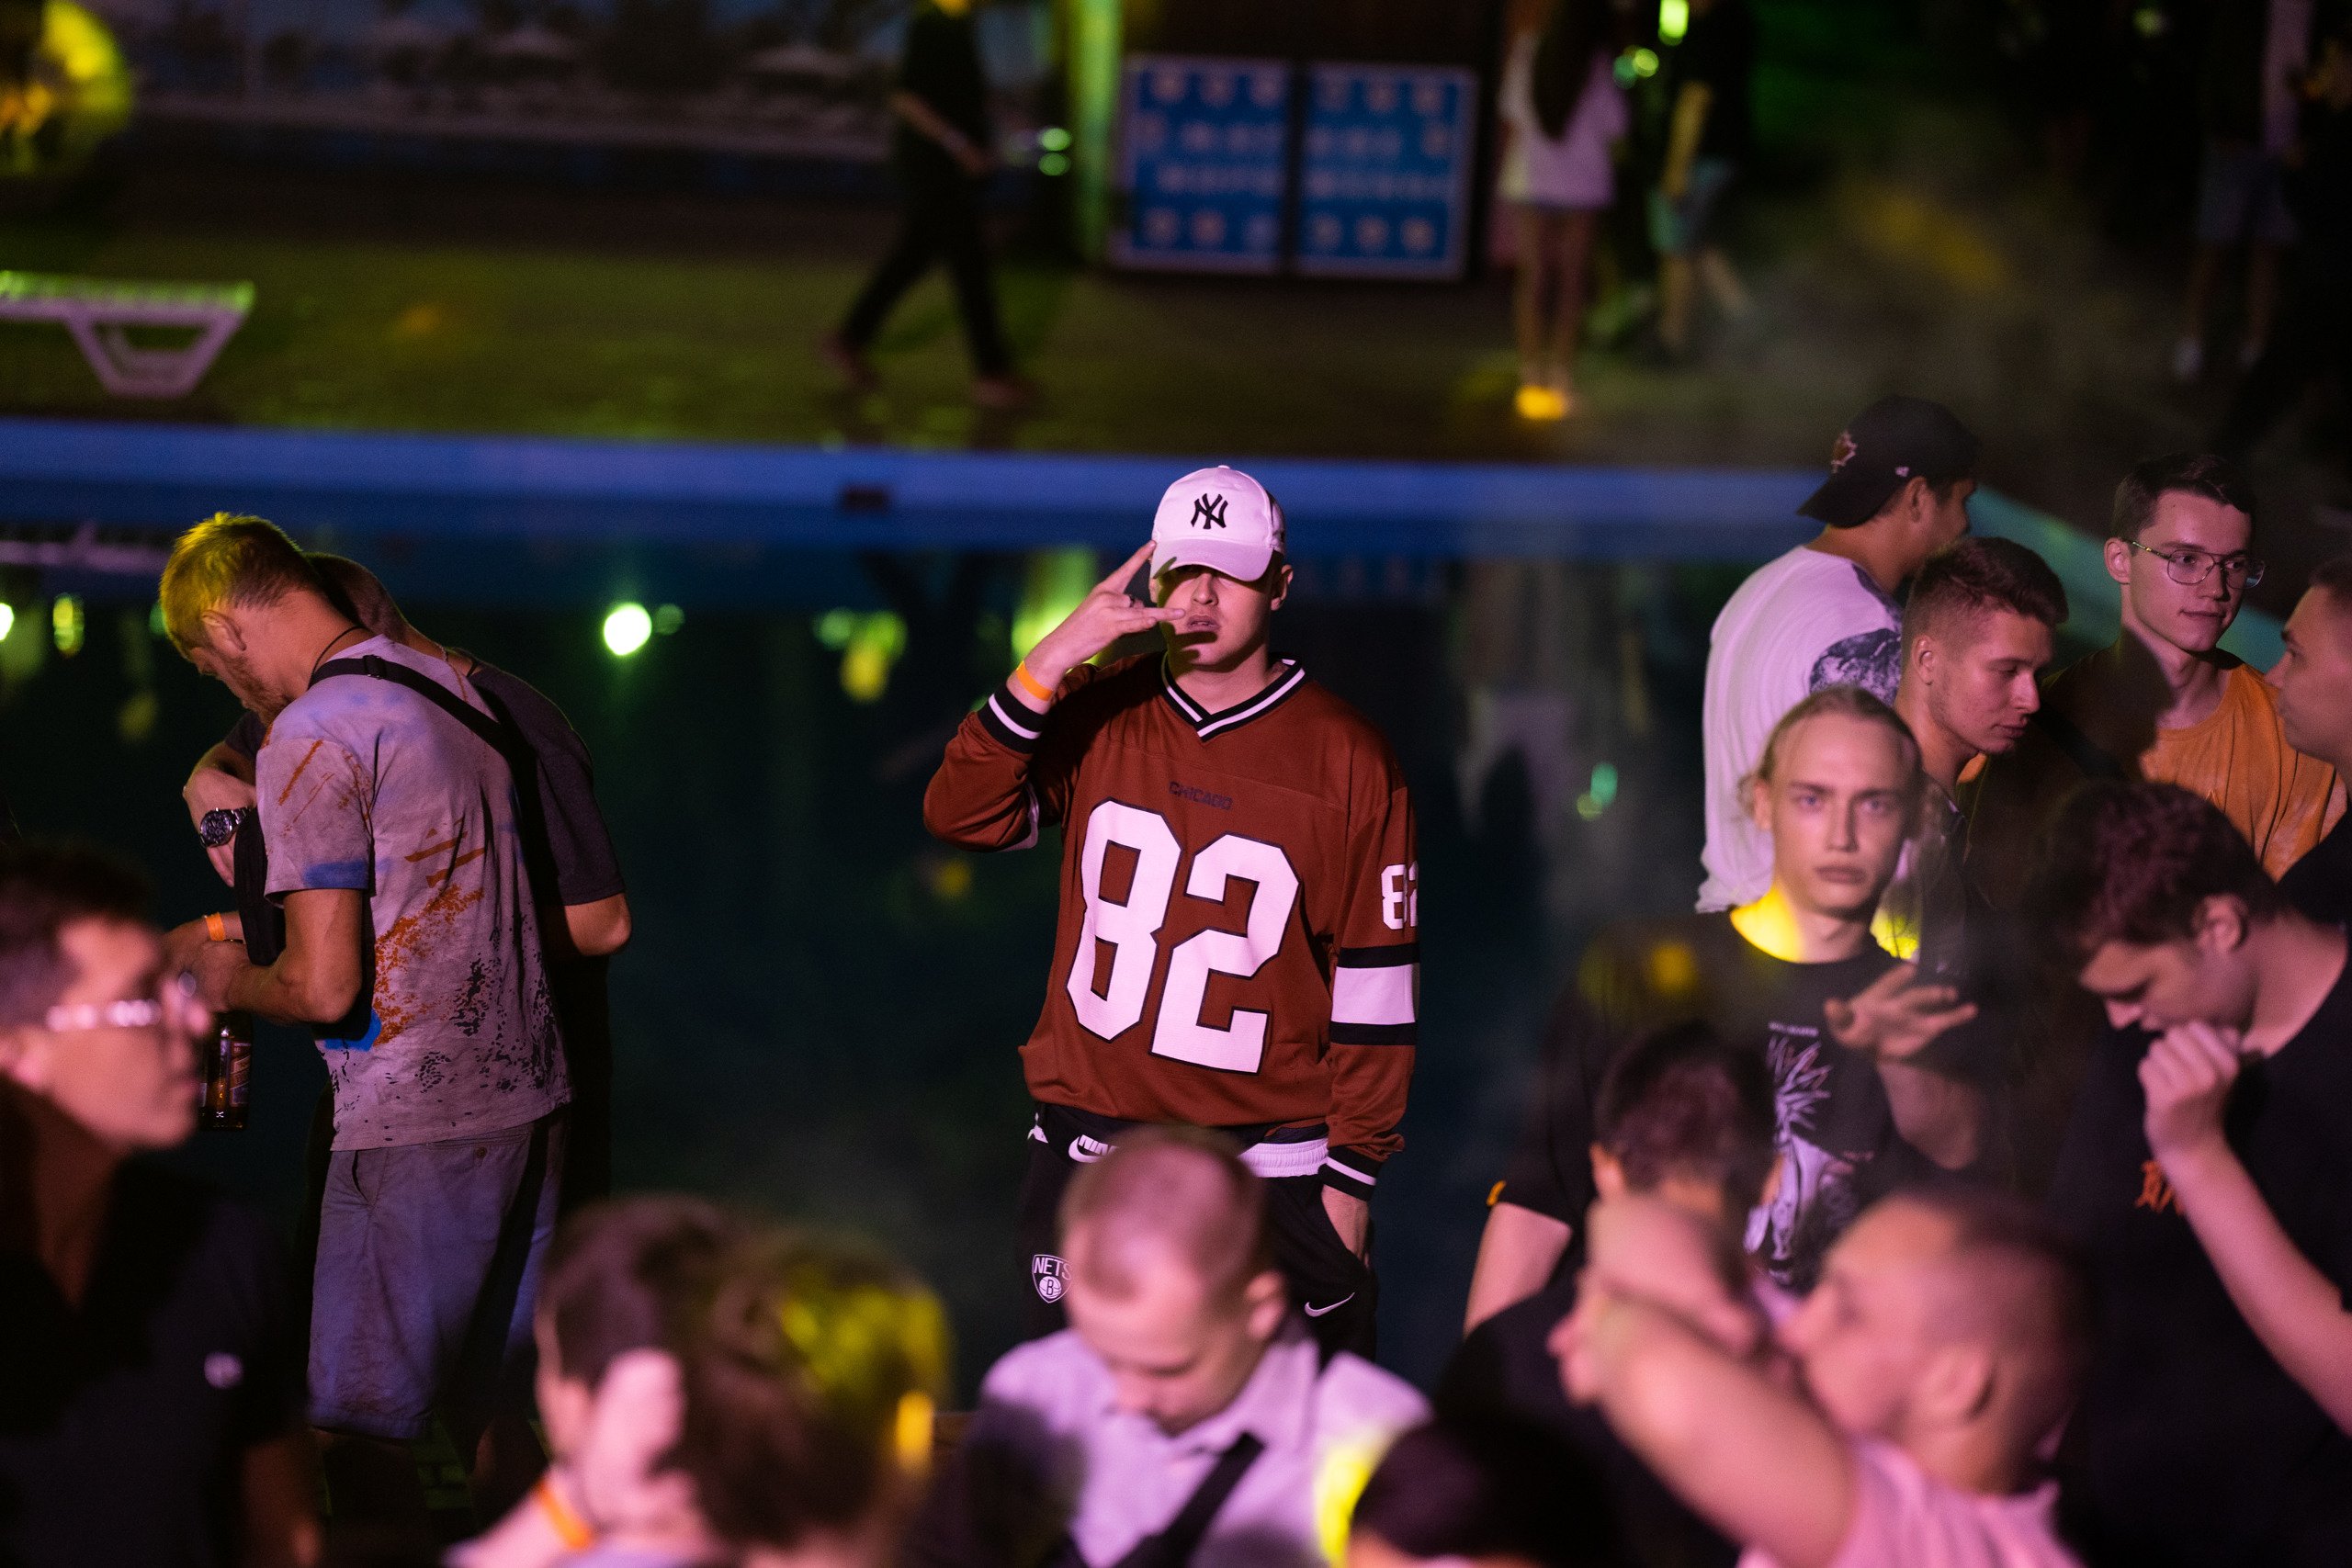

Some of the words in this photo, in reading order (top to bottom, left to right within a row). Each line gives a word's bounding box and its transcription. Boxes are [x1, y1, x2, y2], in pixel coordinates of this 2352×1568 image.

[1191, 493, 1228, 529] NY
[1170, 782, 1233, 810] CHICAGO
[1066, 796, 1300, 1075] 82
[1034, 1258, 1072, 1280] NETS
